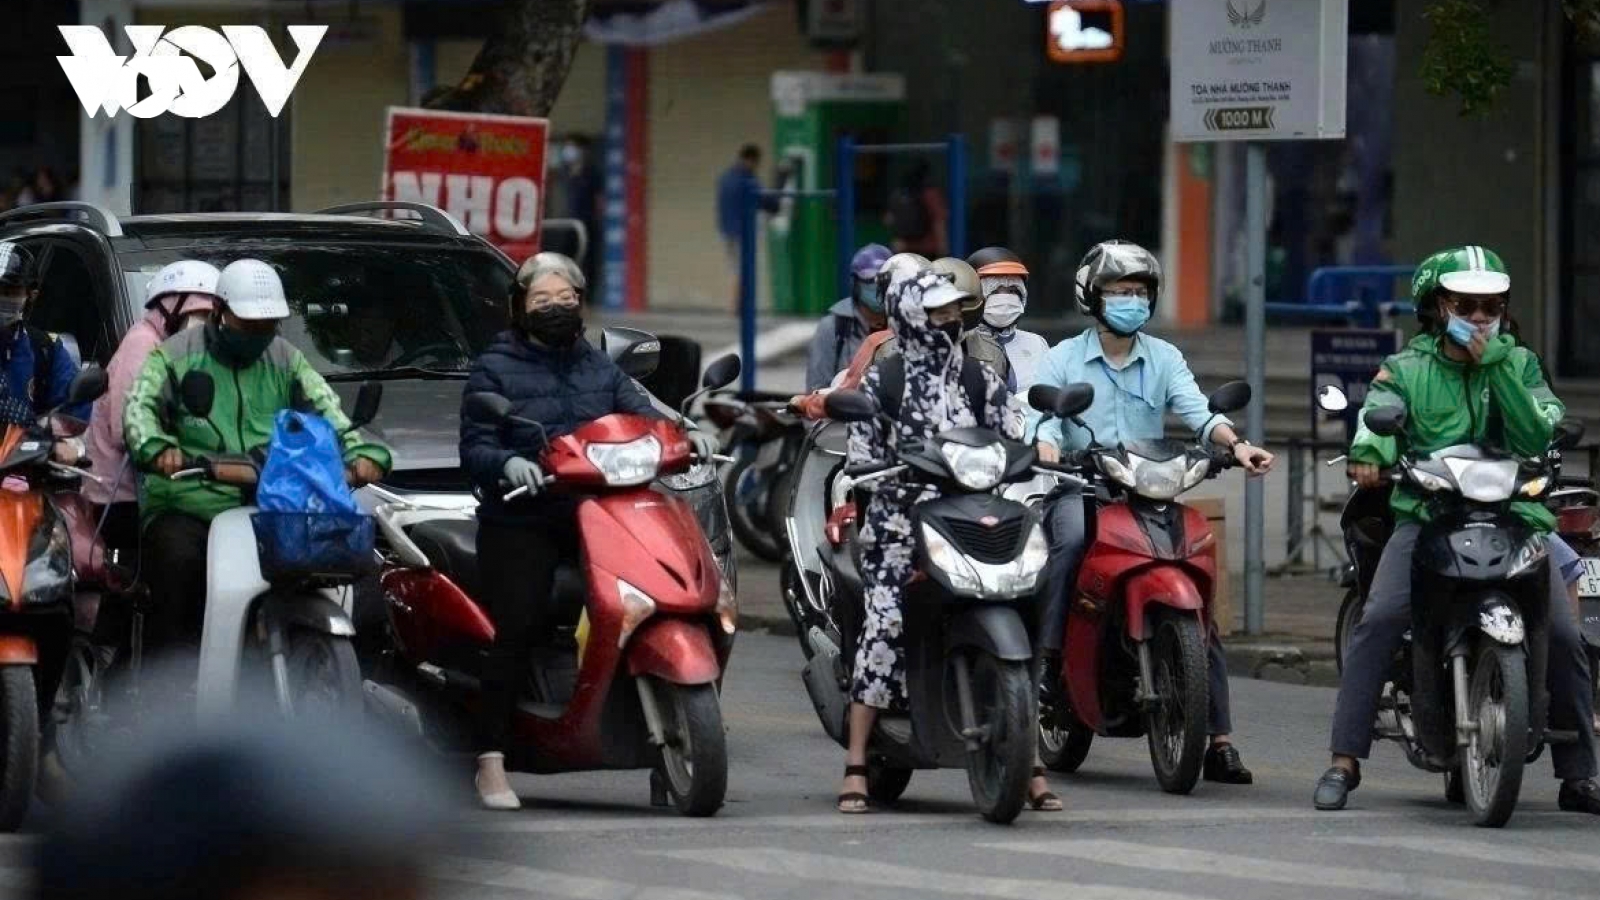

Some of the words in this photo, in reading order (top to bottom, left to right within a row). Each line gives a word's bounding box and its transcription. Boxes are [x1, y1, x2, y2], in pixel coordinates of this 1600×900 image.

[1247, 38, 1282, 52] THANH
[1262, 81, 1291, 92] THANH
[1221, 110, 1249, 126] 1000
[1251, 109, 1263, 125] M
[393, 171, 539, 239] NHO
